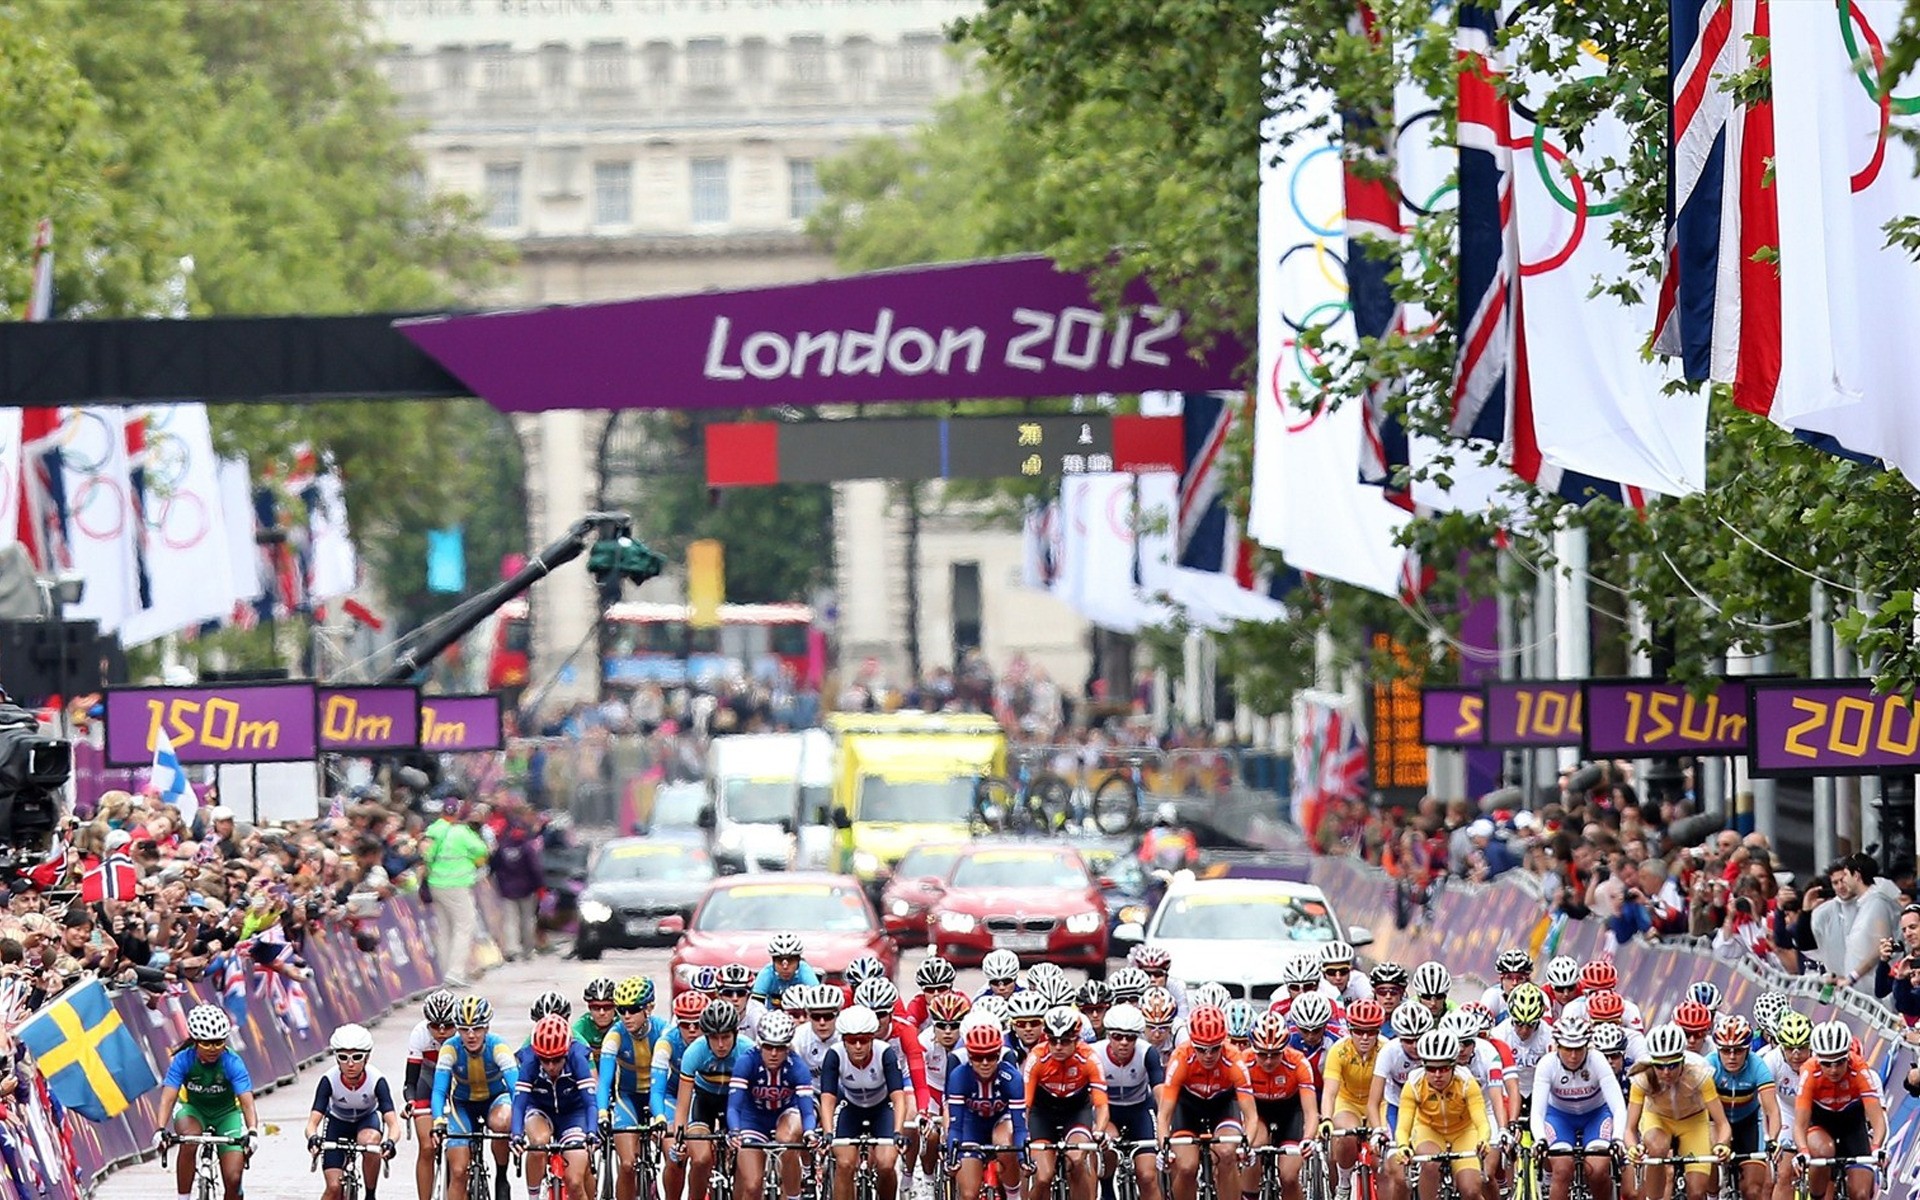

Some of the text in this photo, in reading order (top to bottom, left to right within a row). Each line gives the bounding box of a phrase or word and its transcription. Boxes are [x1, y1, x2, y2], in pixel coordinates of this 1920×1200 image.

[704, 304, 1182, 380] London 2012
[146, 697, 280, 752] 150m
[1784, 694, 1920, 759] 200
[751, 1086, 795, 1101] USA
[965, 1097, 1009, 1113] USA
